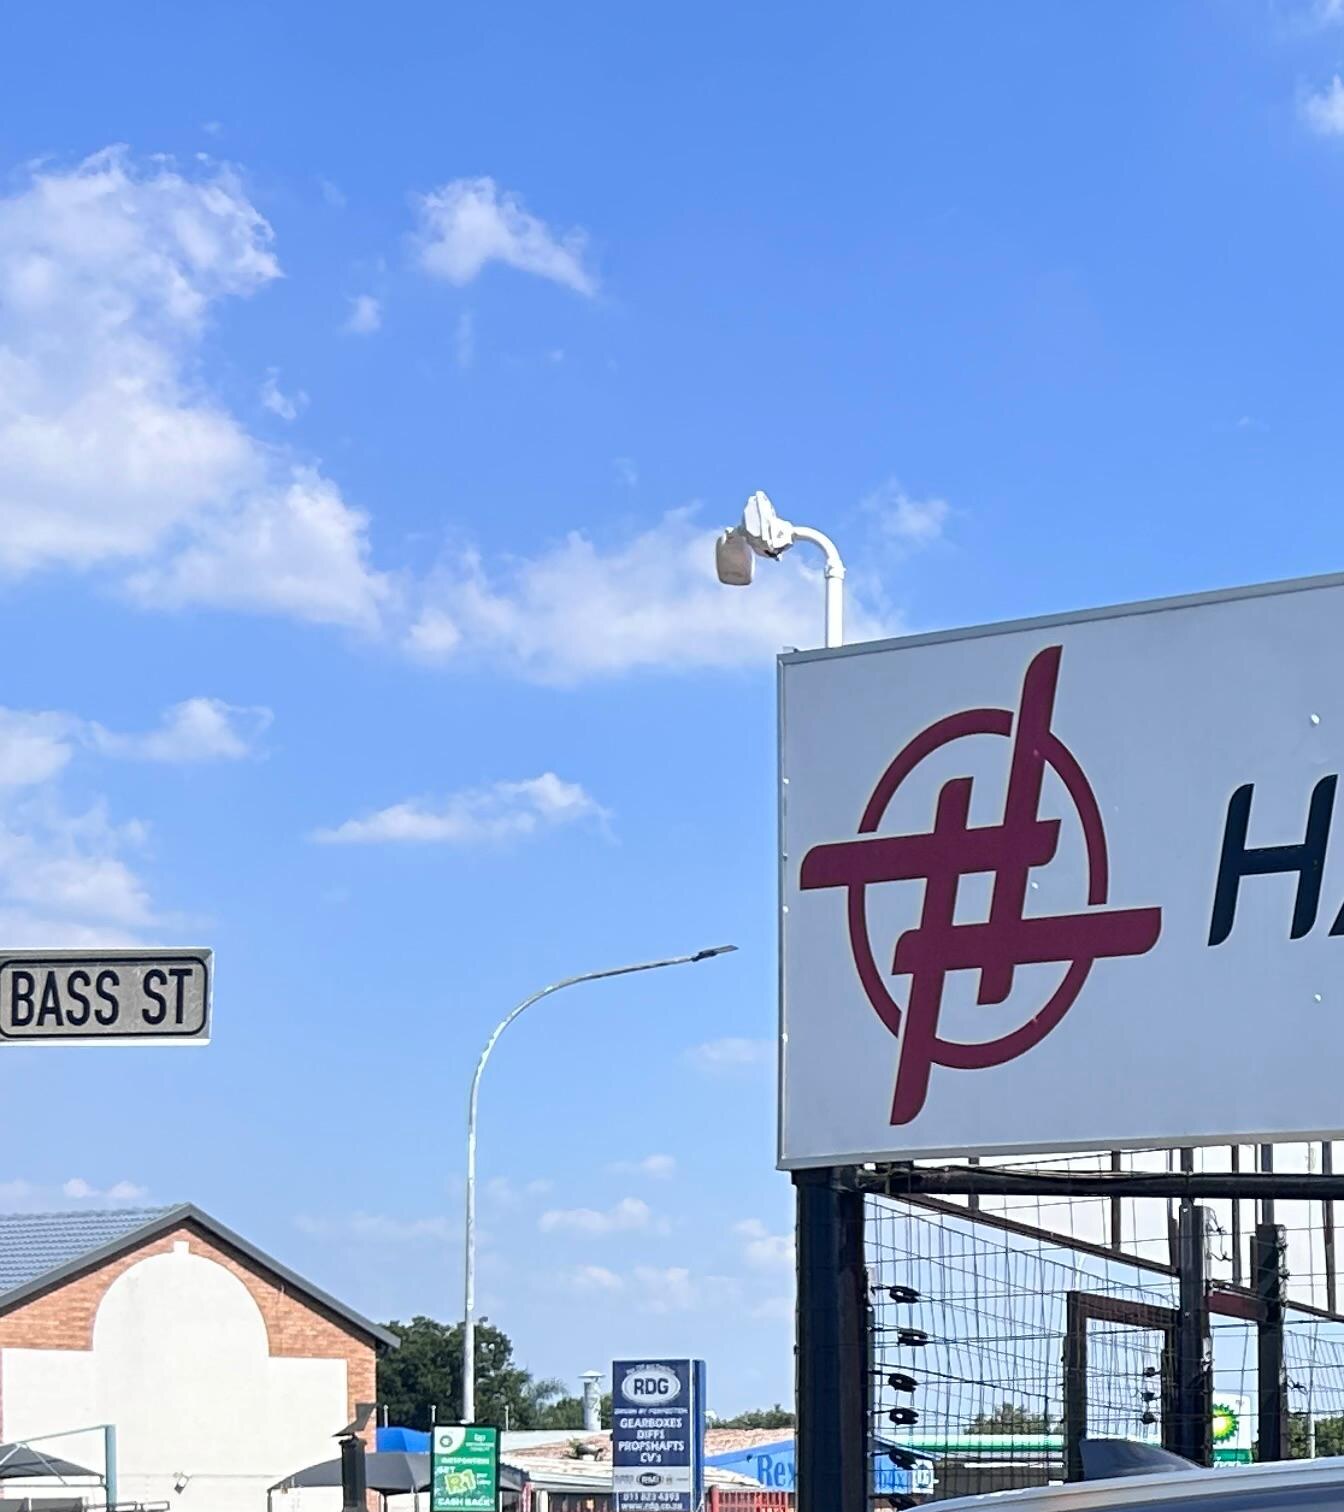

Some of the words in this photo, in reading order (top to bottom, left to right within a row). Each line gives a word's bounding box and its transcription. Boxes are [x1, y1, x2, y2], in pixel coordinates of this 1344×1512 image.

[11, 969, 120, 1027] BASS
[142, 968, 193, 1025] ST
[634, 1377, 669, 1395] RDG
[619, 1418, 682, 1429] GEARBOXES
[618, 1440, 685, 1452] PROPSHAFTS
